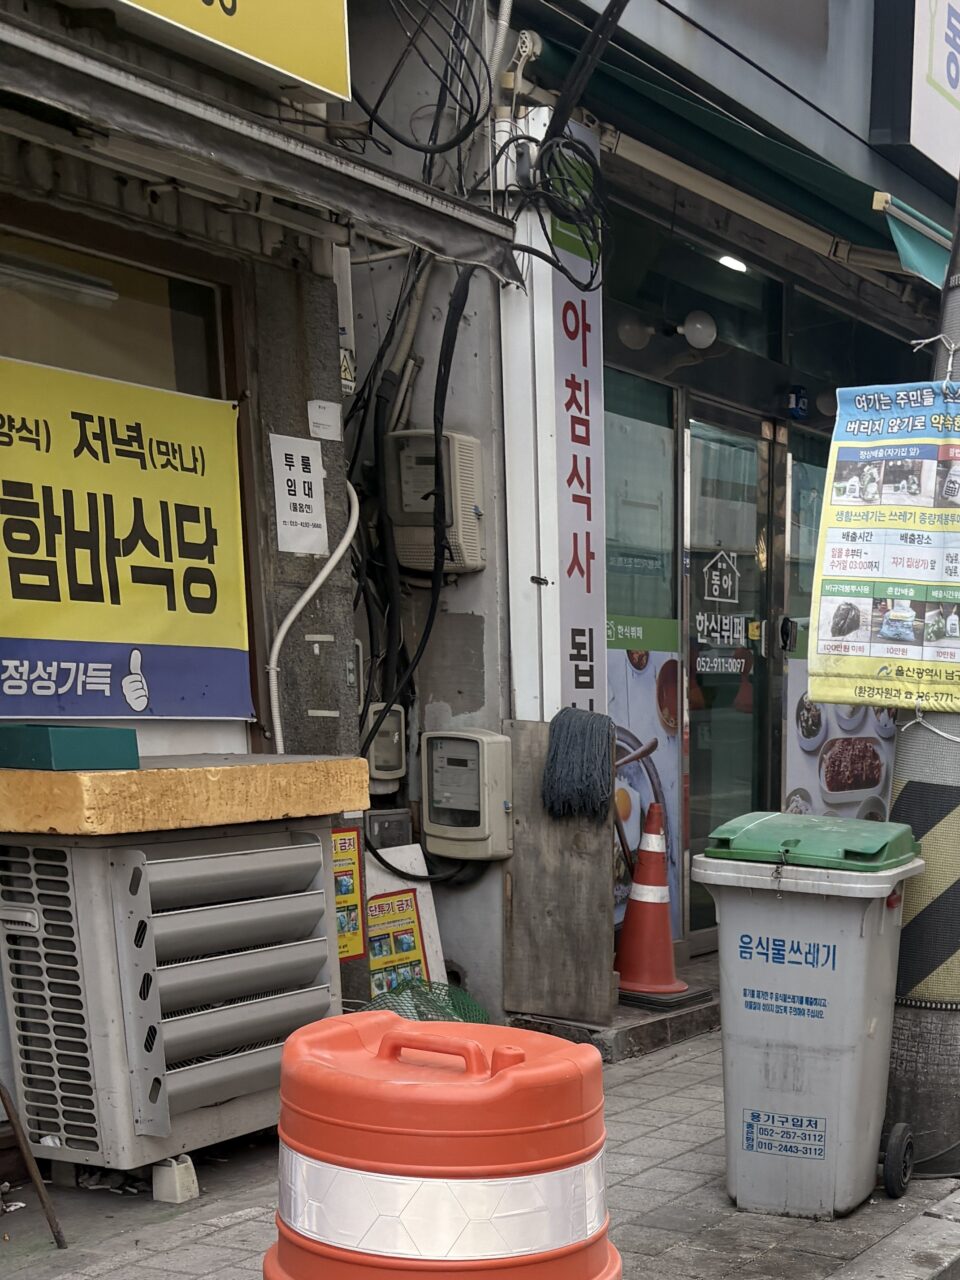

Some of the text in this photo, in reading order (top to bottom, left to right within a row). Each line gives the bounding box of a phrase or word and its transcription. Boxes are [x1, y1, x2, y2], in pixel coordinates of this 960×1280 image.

[855, 393, 892, 412] 여기는
[895, 388, 935, 408] 주민들
[845, 418, 884, 436] 버리지
[887, 416, 926, 434] 않기로
[560, 298, 596, 594] 아침식사
[835, 511, 886, 523] 생활쓰레기는
[888, 511, 917, 524] 쓰레기
[842, 531, 873, 542] 배출시간
[899, 532, 933, 545] 배출장소
[0, 479, 218, 615] 함바식당
[711, 570, 733, 597] 동아
[616, 624, 644, 641] 한식뷔페
[696, 611, 746, 646] 한식뷔페
[696, 656, 746, 673] 052-911-0097
[895, 665, 942, 680] 울산광역시
[1, 658, 113, 698] 정성가득
[854, 685, 902, 700] (환경자원과
[338, 836, 356, 851] 금지
[368, 897, 414, 918] 단투기 금지
[739, 934, 837, 971] 음식물쓰레기
[750, 1111, 819, 1130] 용기구입처
